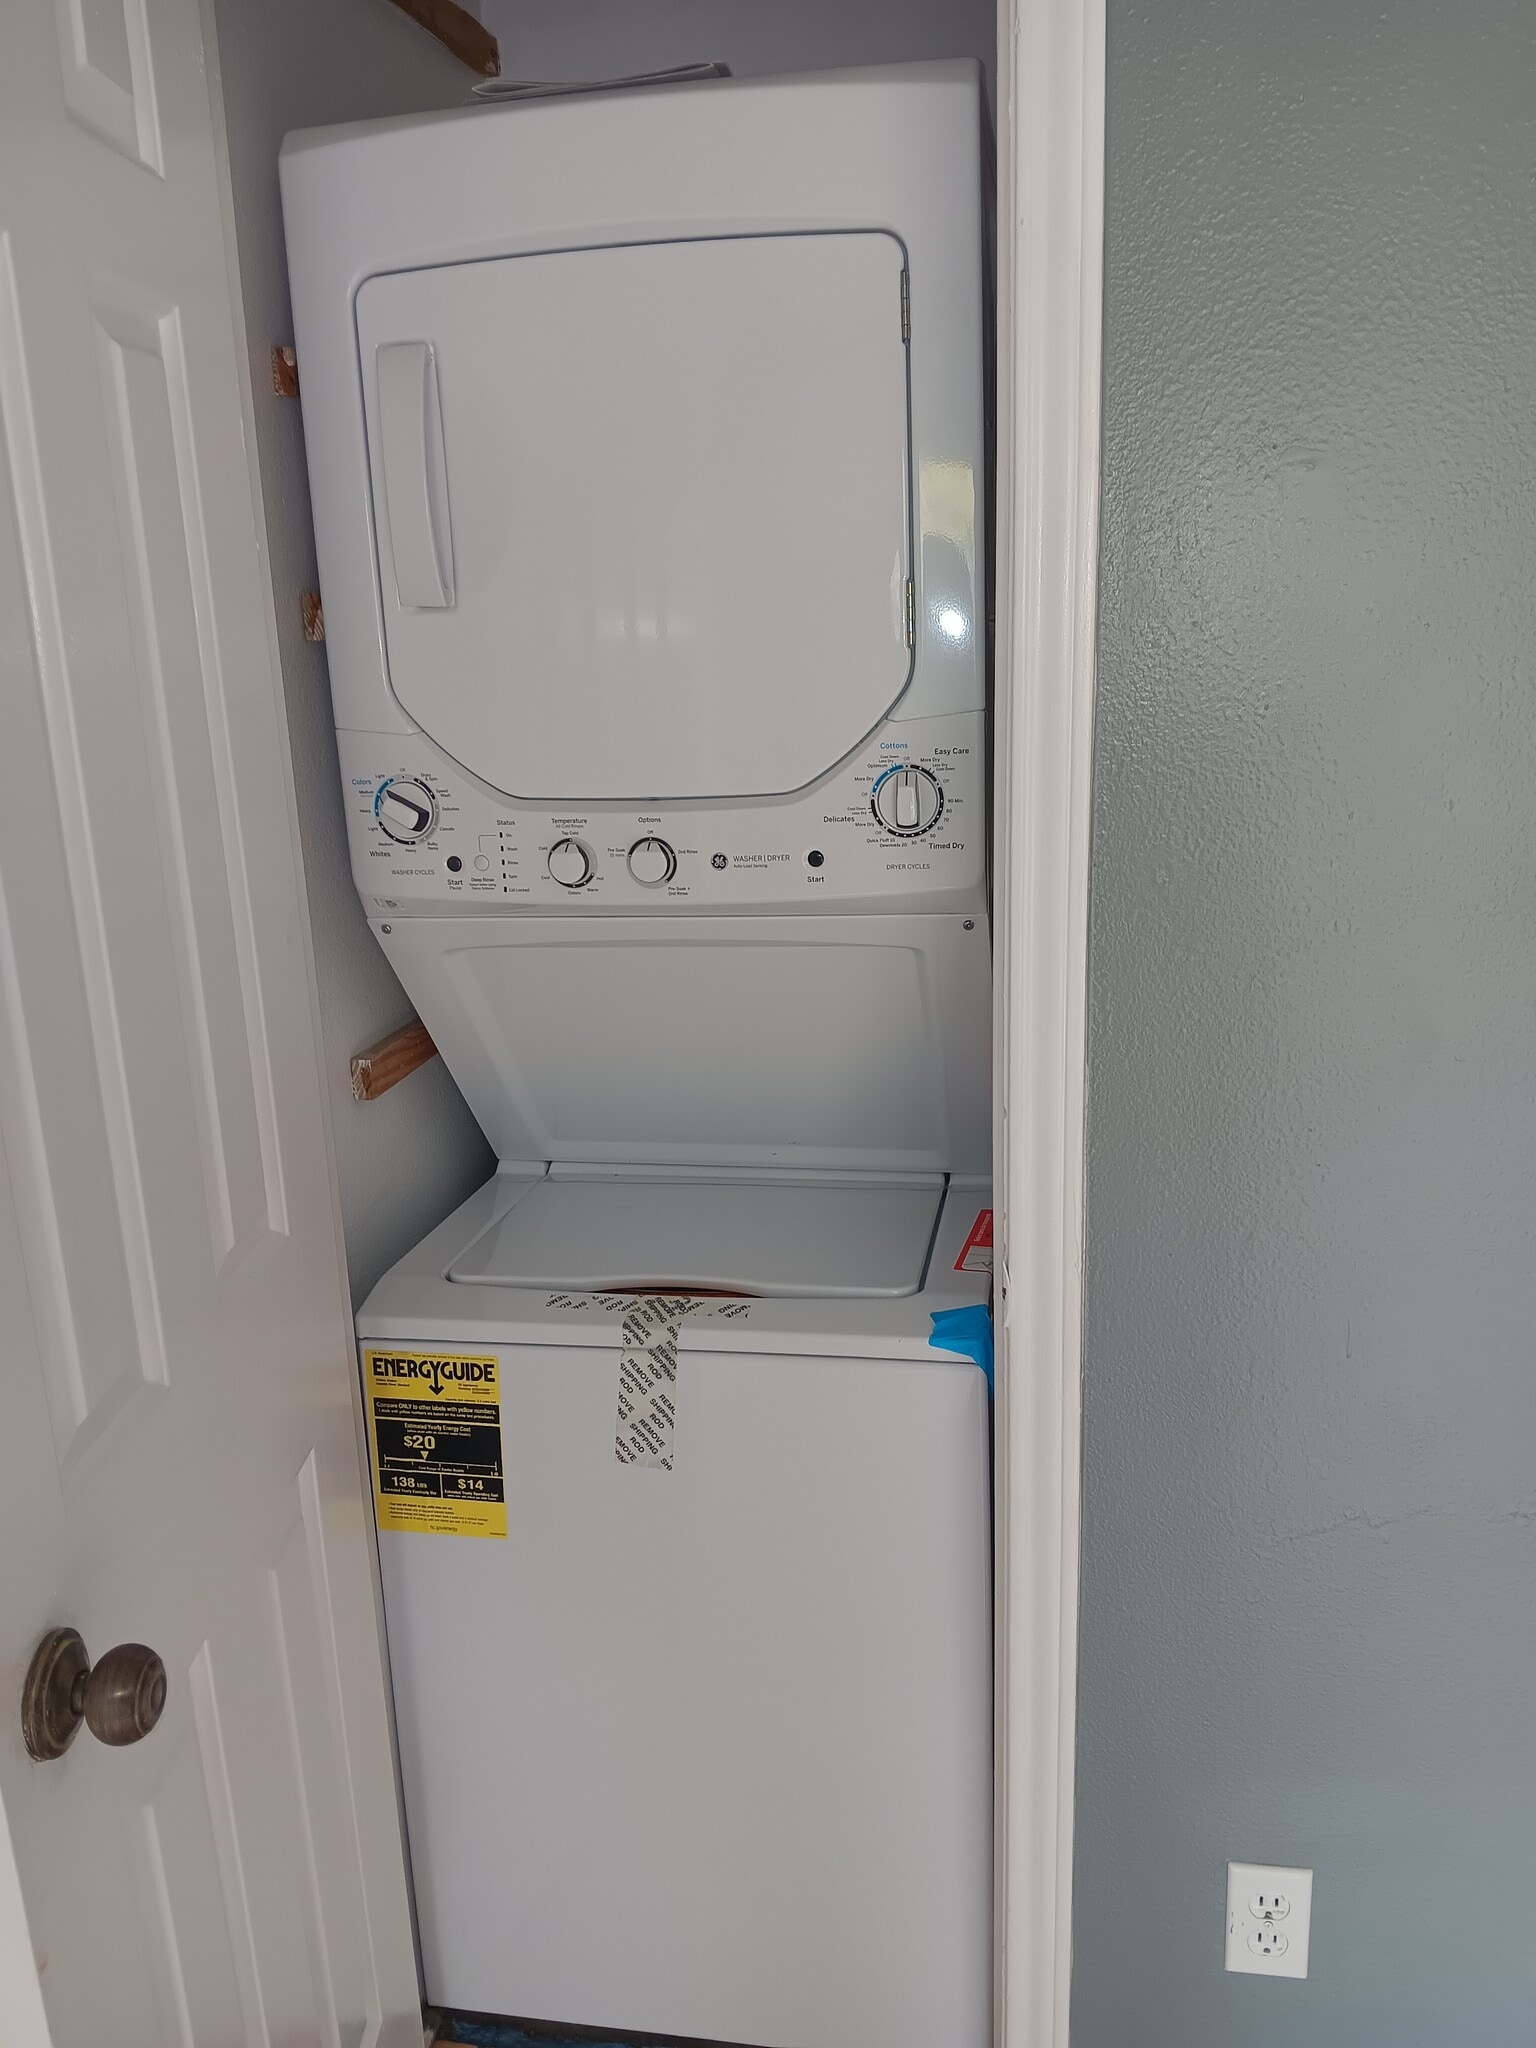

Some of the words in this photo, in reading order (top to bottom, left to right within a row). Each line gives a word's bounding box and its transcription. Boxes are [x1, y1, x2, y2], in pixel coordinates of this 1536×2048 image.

[880, 742, 908, 750] Cottons
[935, 748, 951, 756] Easy
[823, 815, 855, 823] Delicates
[951, 842, 965, 850] Dry
[732, 854, 762, 862] WASHER
[766, 853, 791, 861] DRYER
[447, 878, 463, 886] Start
[640, 1309, 653, 1322] ROD
[628, 1313, 652, 1339] REMOVE
[372, 1357, 496, 1384] ENERGYGUIDE
[647, 1348, 676, 1381] SHIPPING
[647, 1362, 662, 1379] ROD
[620, 1362, 648, 1395] SHIPPING
[627, 1358, 655, 1389] REMOVE
[619, 1377, 634, 1393] ROD
[427, 1423, 442, 1431] Yearly
[442, 1424, 459, 1432] Energy
[649, 1413, 664, 1429] ROD
[629, 1423, 658, 1455] SHIPPING
[638, 1418, 666, 1448] REMOVE
[403, 1435, 435, 1449] $20
[629, 1436, 645, 1452] ROD
[391, 1476, 415, 1488] 138
[457, 1478, 484, 1490] $14
